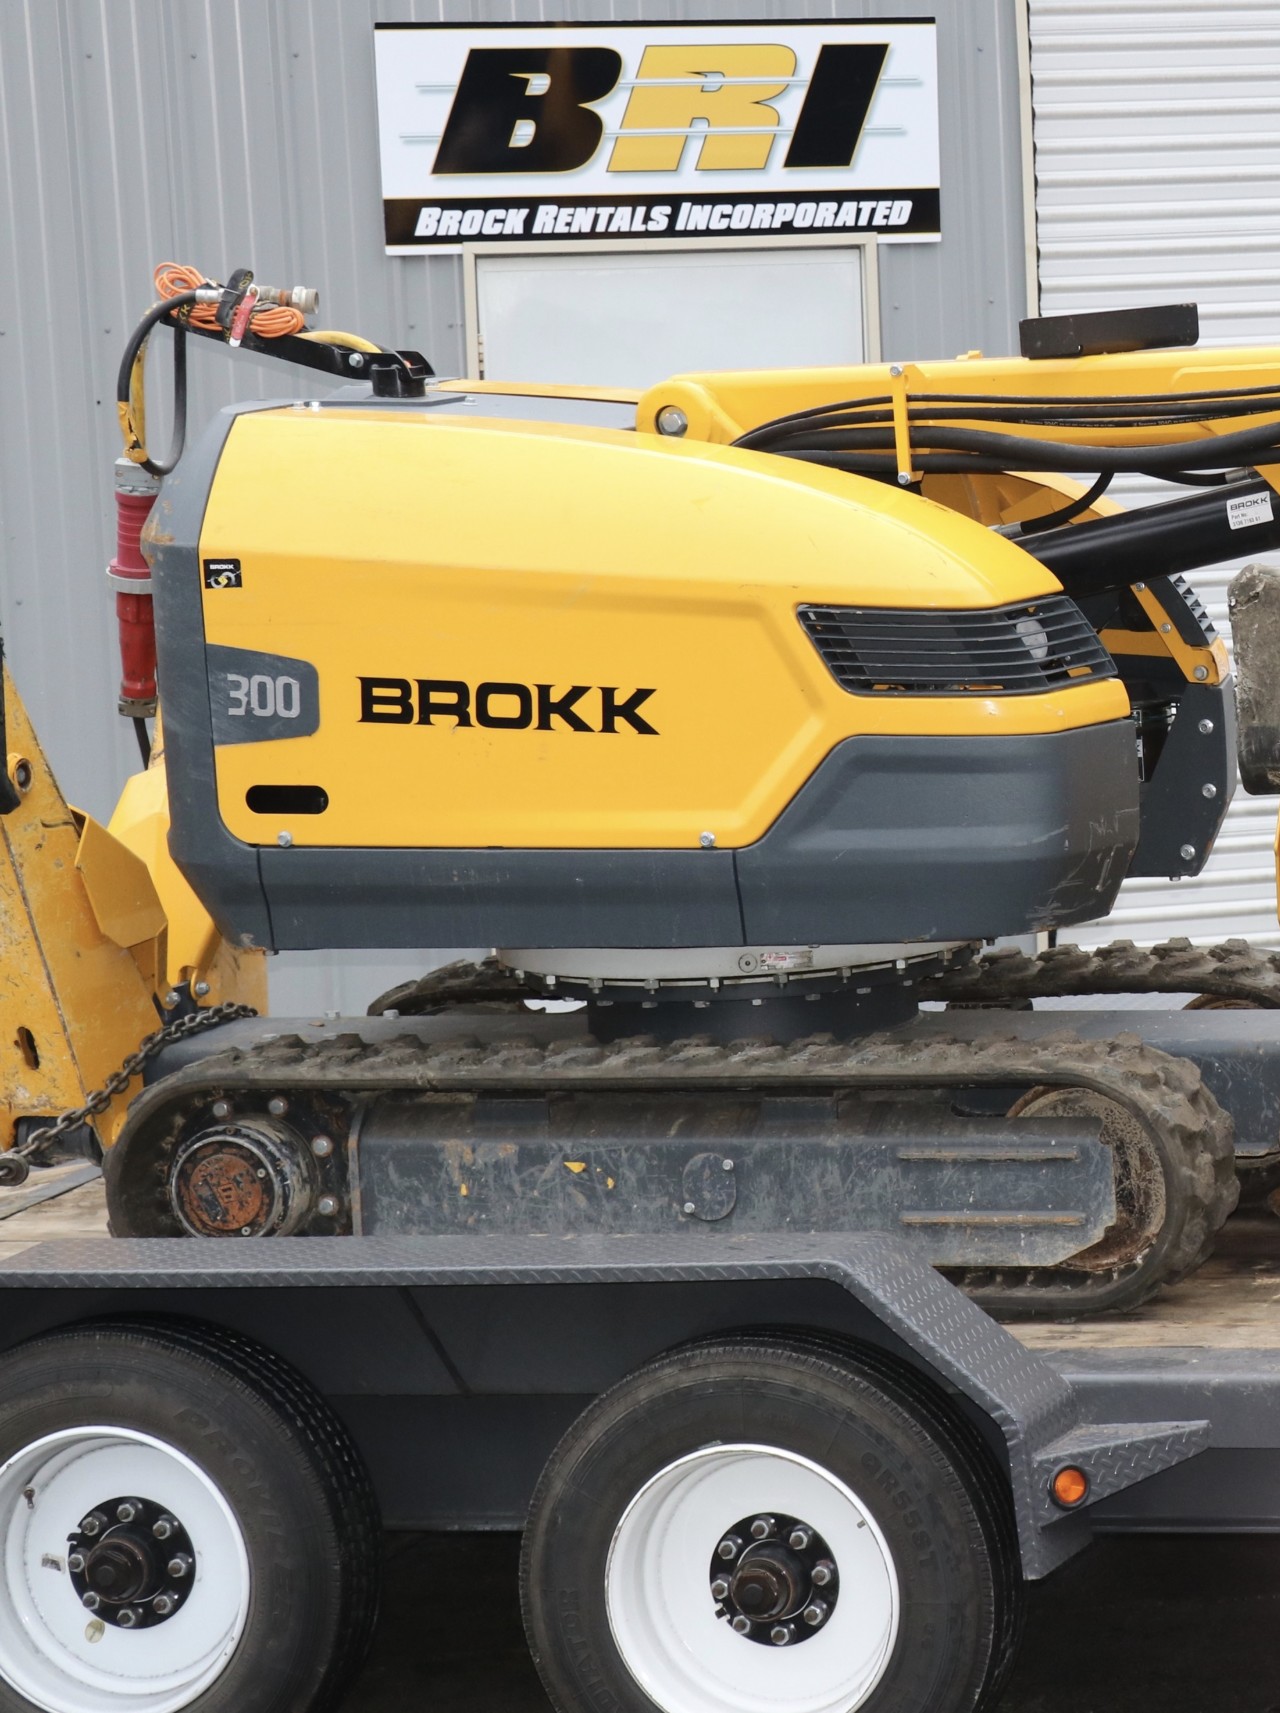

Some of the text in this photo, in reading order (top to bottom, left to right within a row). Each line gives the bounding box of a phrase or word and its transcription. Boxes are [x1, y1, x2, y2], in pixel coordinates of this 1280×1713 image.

[430, 43, 891, 176] BRI
[415, 200, 912, 237] BROCK RENTALS INCORPORATED
[1231, 497, 1268, 510] BROKK
[227, 674, 301, 718] 300
[355, 676, 661, 736] BROKK
